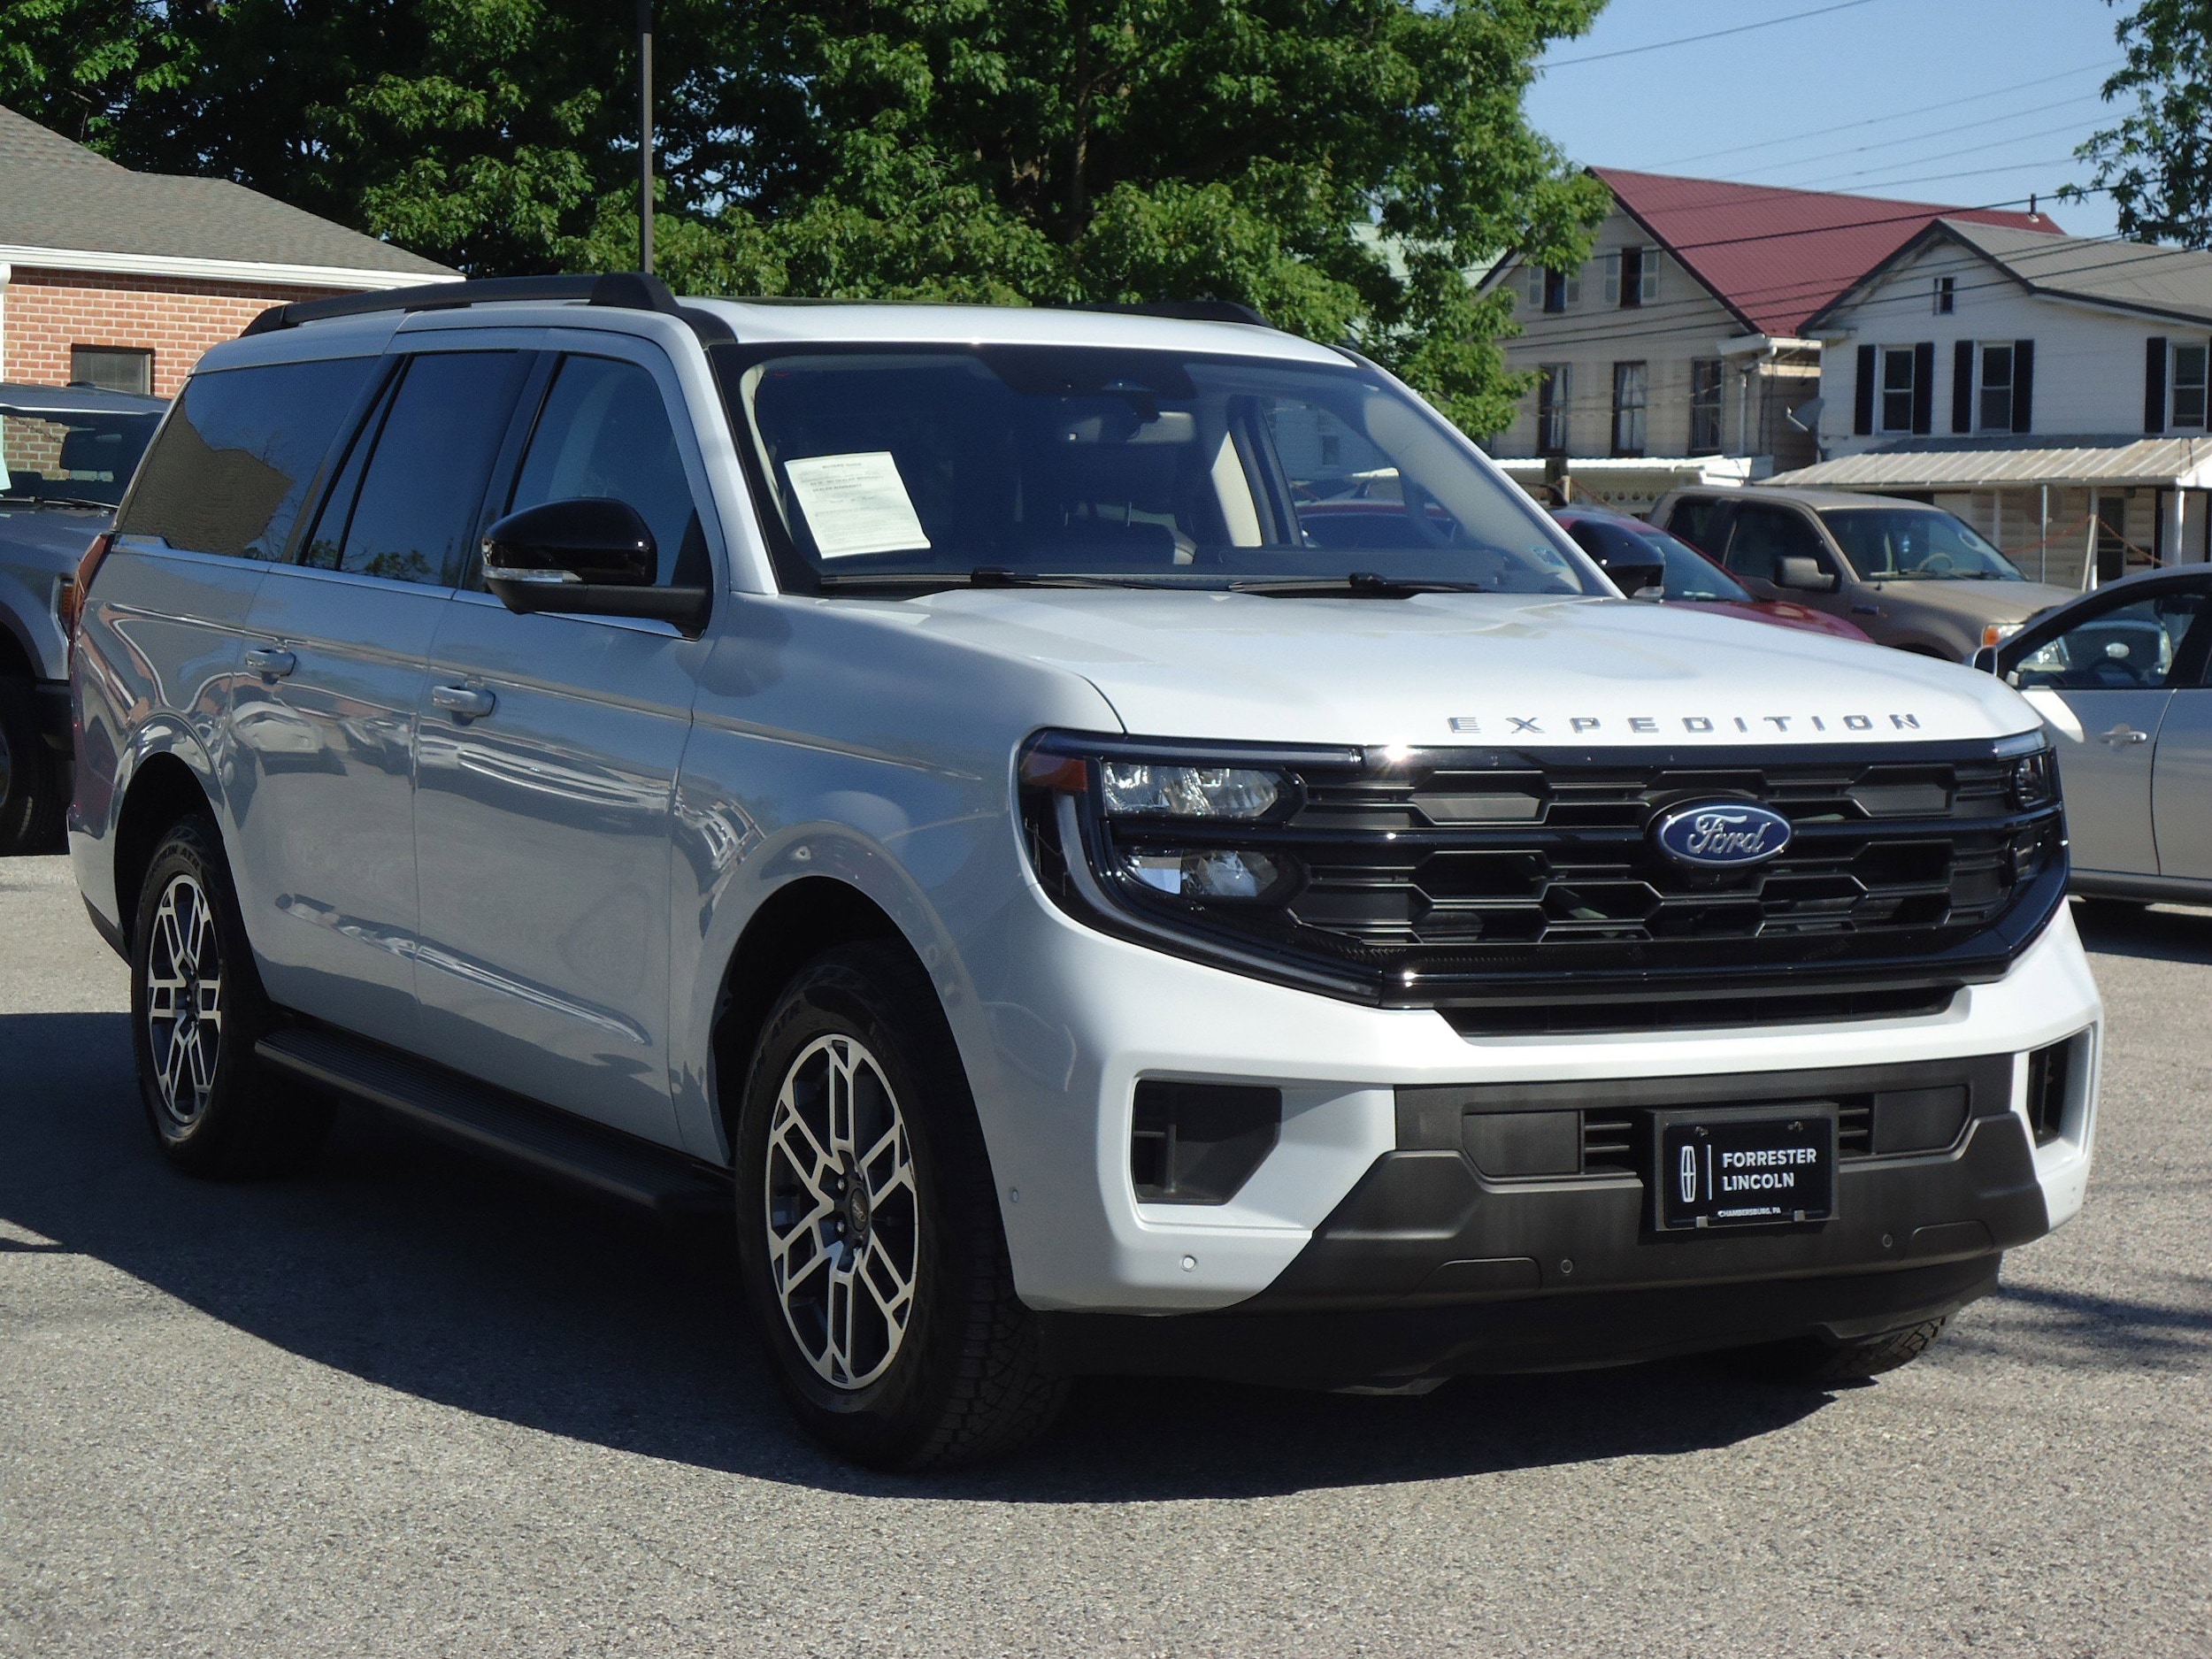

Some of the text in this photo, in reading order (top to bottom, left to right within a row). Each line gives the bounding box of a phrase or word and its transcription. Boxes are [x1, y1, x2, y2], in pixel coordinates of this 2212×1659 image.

[1448, 713, 1922, 734] EXPEDITION
[1687, 813, 1772, 855] Ford
[1724, 1148, 1816, 1168] FORRESTER
[1724, 1172, 1794, 1191] LINCOLN
